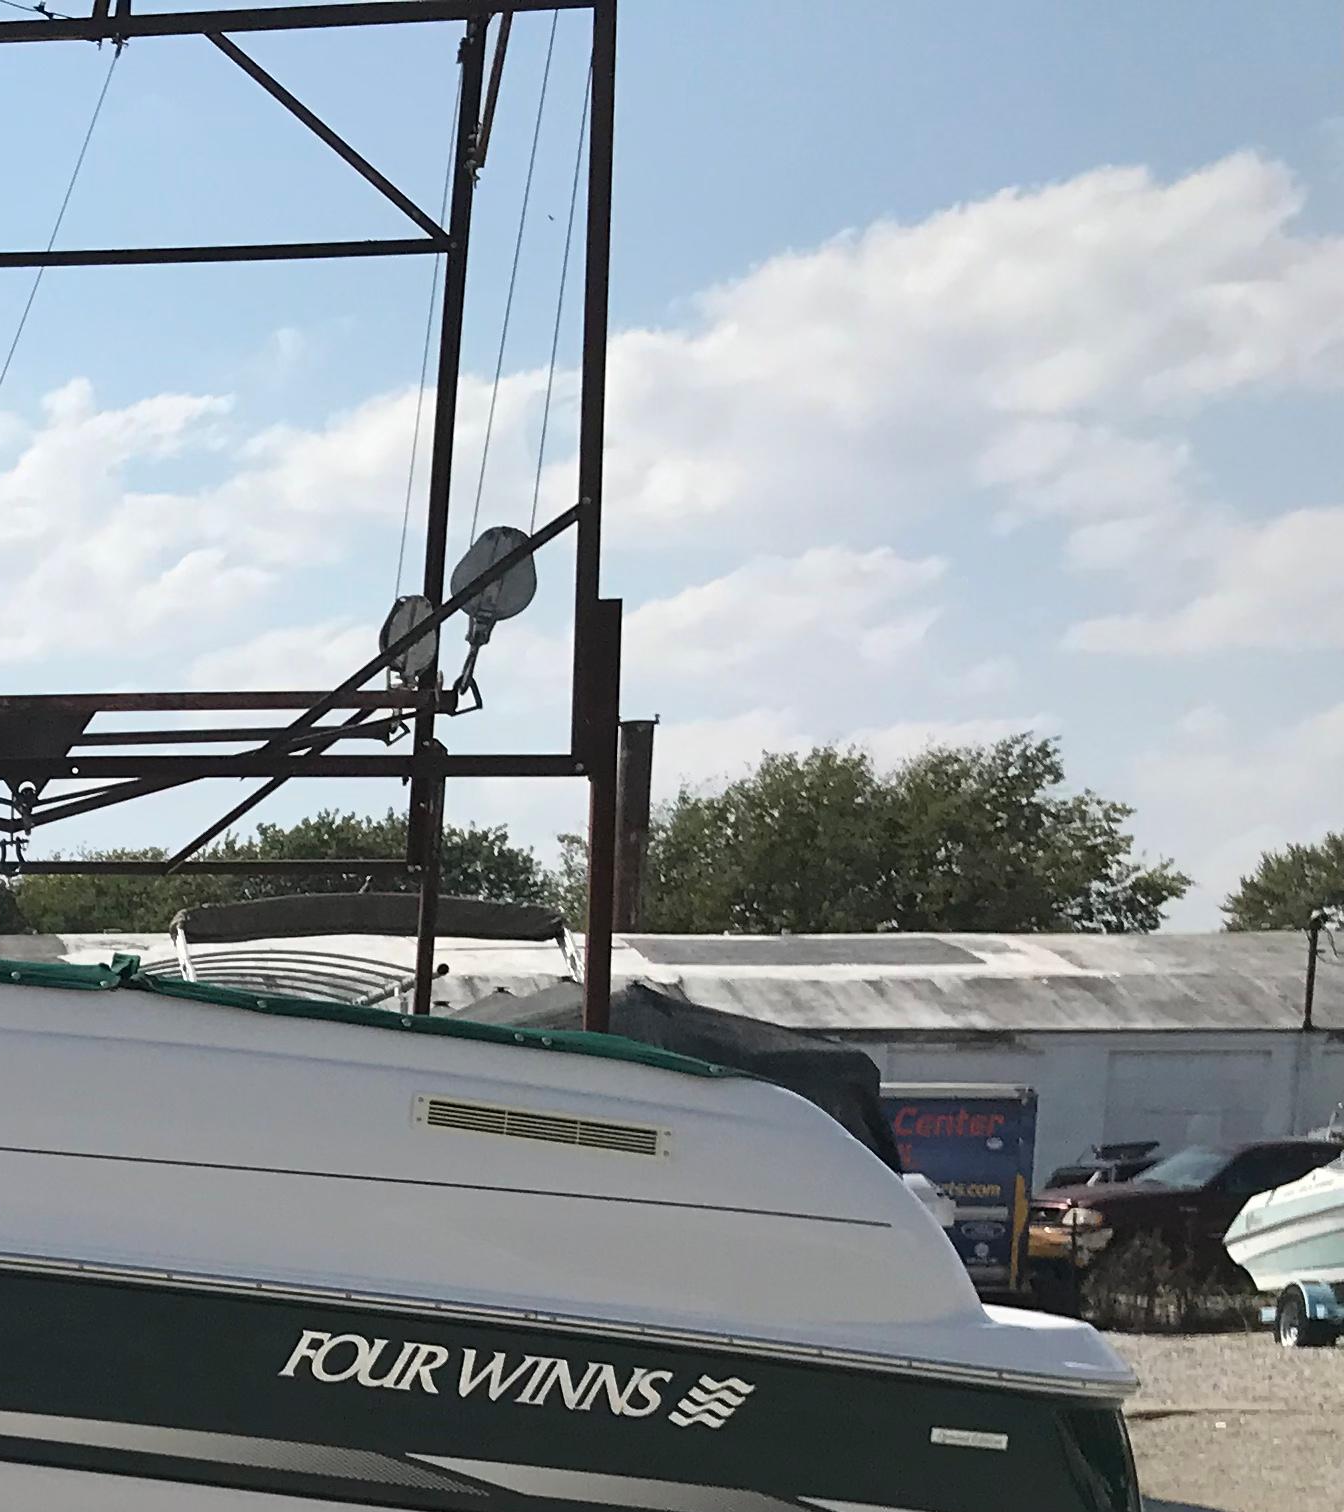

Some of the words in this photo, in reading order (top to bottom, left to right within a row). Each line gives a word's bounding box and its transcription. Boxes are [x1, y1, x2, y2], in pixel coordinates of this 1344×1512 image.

[894, 1107, 1005, 1137] Center
[278, 1329, 449, 1394] FOUR
[457, 1347, 673, 1418] WINNS
